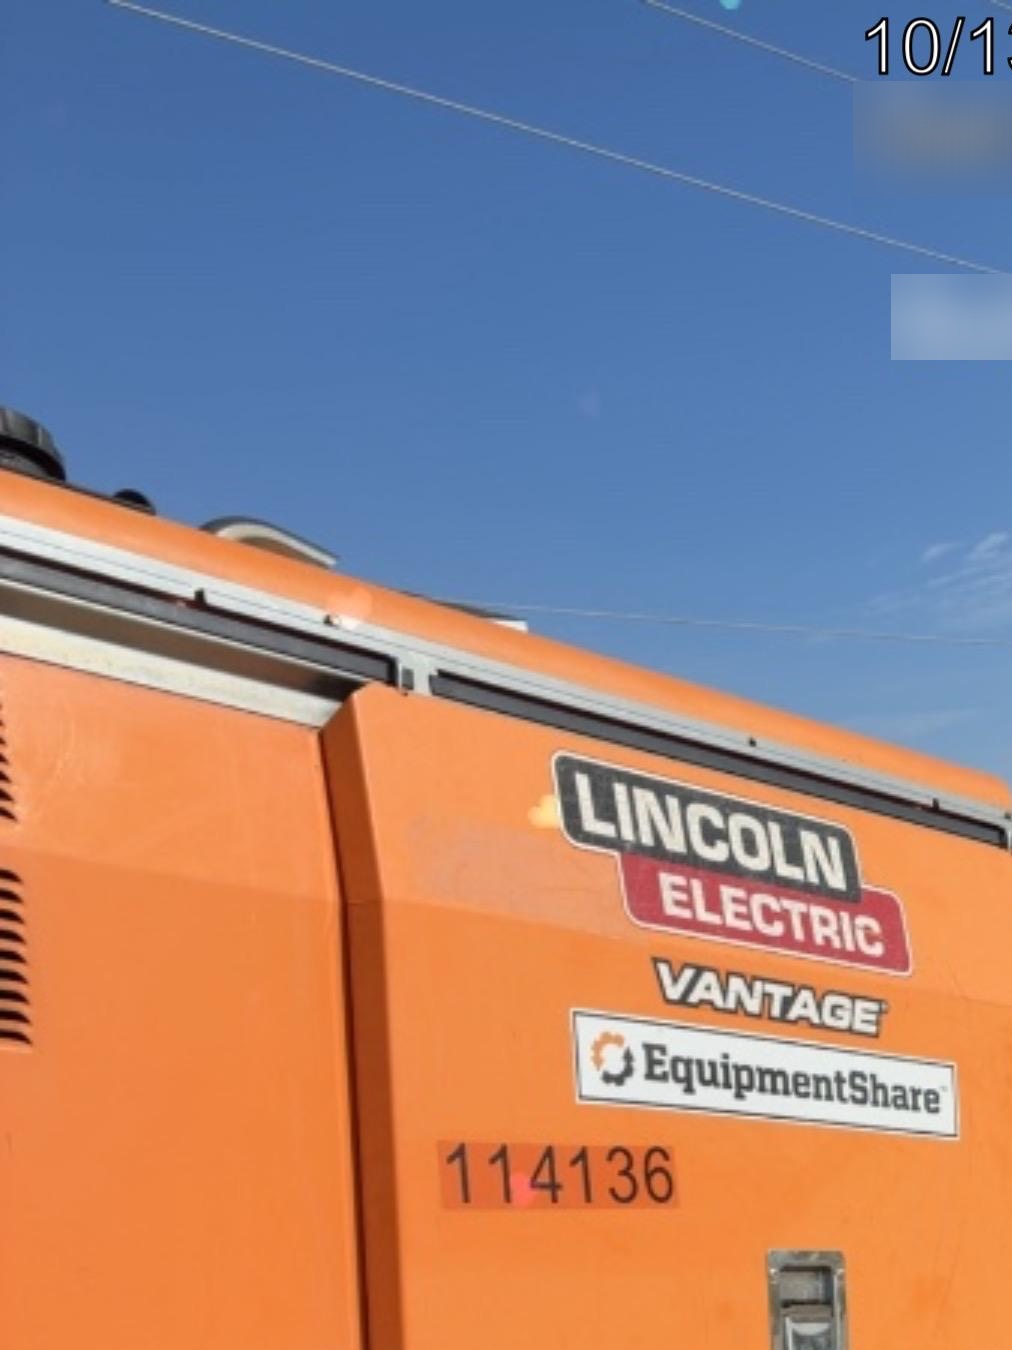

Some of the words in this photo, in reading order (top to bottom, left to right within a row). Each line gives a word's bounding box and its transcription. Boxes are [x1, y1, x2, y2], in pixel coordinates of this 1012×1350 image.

[574, 771, 848, 891] LINCOLN
[657, 871, 886, 958] ELECTRIC
[651, 957, 887, 1037] VANTAGE
[642, 1042, 942, 1115] EquipmentShare
[446, 1142, 673, 1204] 114136
